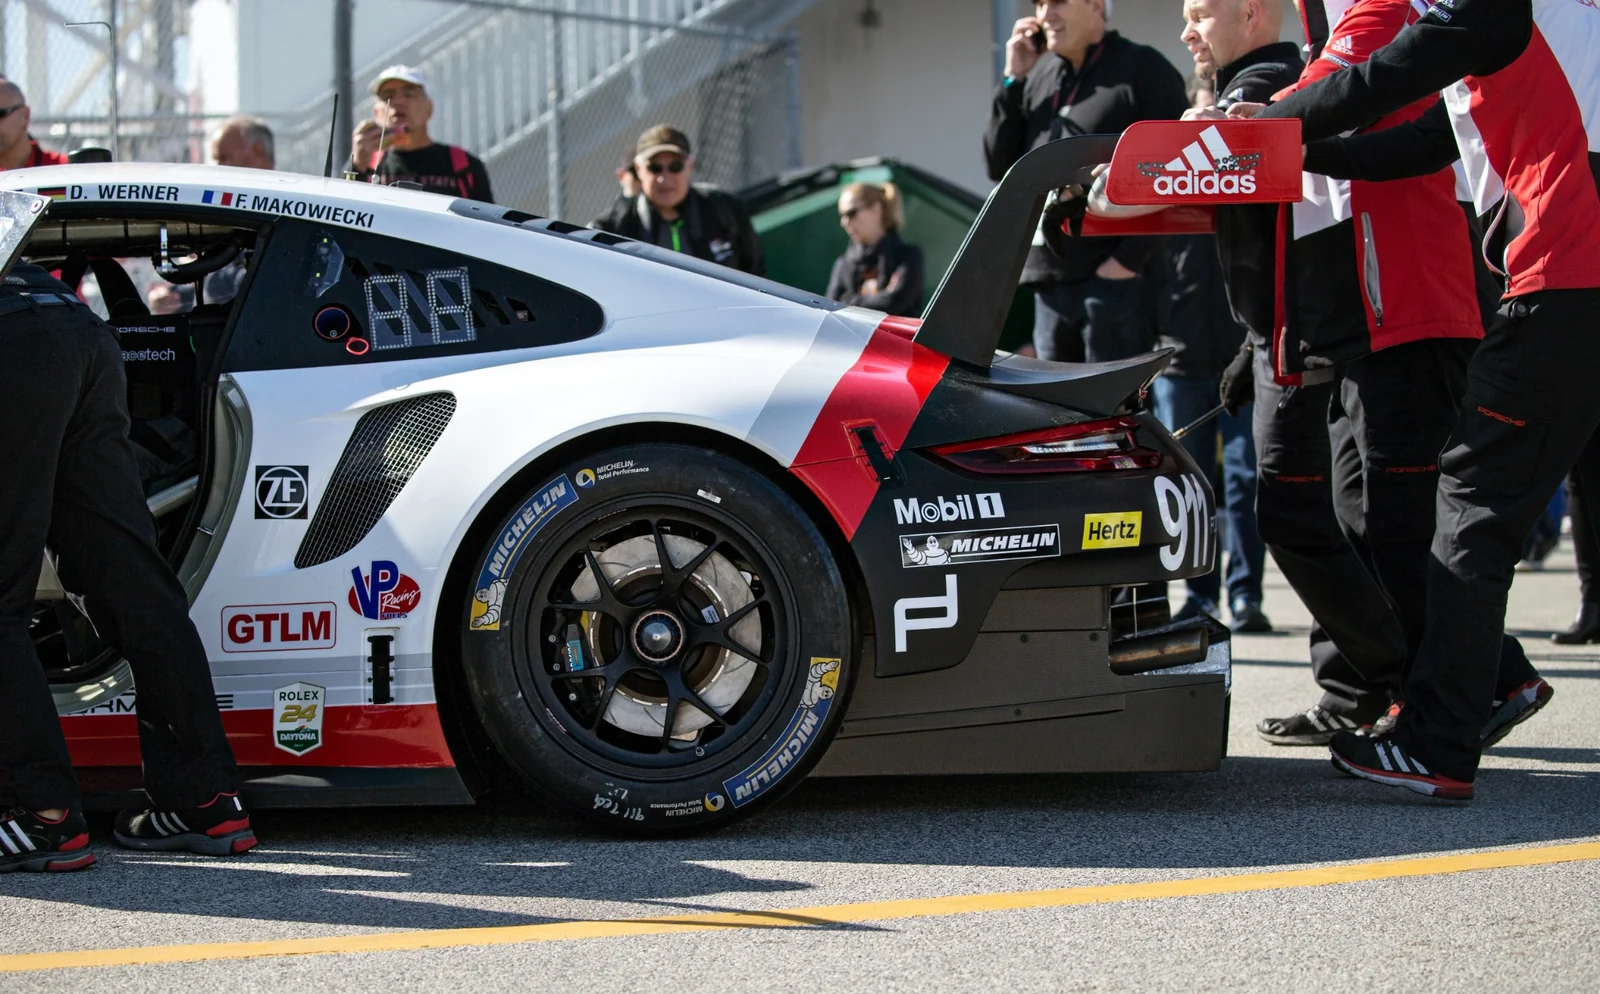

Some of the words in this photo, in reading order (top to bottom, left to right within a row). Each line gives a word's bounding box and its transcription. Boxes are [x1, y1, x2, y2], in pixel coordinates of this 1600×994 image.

[70, 185, 88, 200] D.
[98, 184, 179, 201] WERNER
[1153, 170, 1257, 195] adidas
[235, 193, 247, 209] F.
[251, 195, 374, 228] MAKOWIECKI
[1477, 406, 1526, 427] PORSCHE
[596, 460, 634, 474] MICHELIN
[597, 471, 612, 481] Total
[612, 467, 650, 477] Performance
[1385, 463, 1436, 473] PORSCHE
[1275, 474, 1323, 482] PORSCHE
[258, 474, 305, 509] ZF
[893, 494, 975, 524] Mobil
[488, 481, 566, 578] MICHELIN
[1153, 473, 1208, 572] 911
[950, 532, 1056, 553] MICHELIN
[351, 560, 399, 620] VP
[381, 588, 421, 613] Racing
[227, 610, 331, 644] GTLM
[279, 690, 319, 701] ROLEX
[279, 703, 318, 723] 24
[280, 733, 317, 741] DAYTONA
[735, 710, 819, 801] MICHELIN
[649, 801, 687, 810] Performance
[665, 805, 703, 817] MICHELIN
[688, 799, 703, 807] Total
